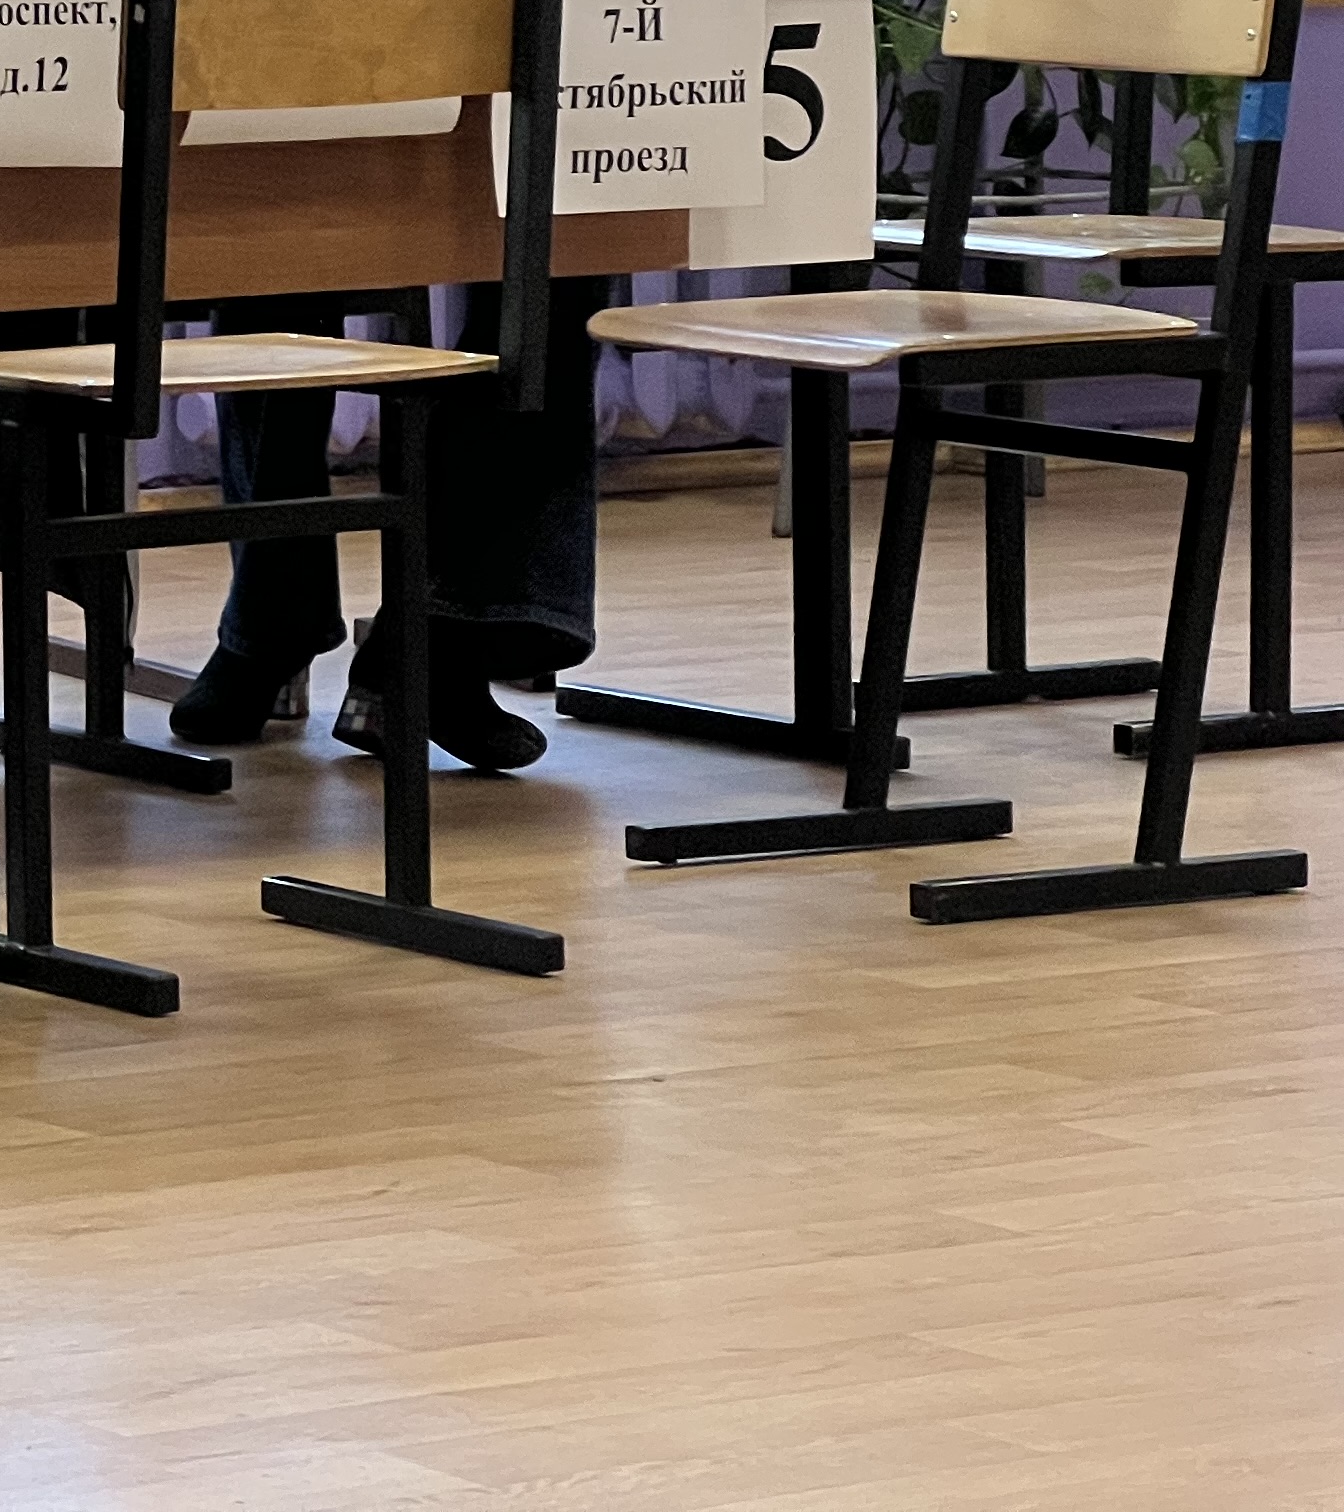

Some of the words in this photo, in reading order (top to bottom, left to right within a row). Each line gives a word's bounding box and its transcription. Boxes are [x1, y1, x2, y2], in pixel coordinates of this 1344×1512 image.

[0, 55, 69, 97] д.12
[555, 68, 747, 119] тябрьский
[763, 22, 825, 162] 5
[566, 145, 689, 184] проезд
